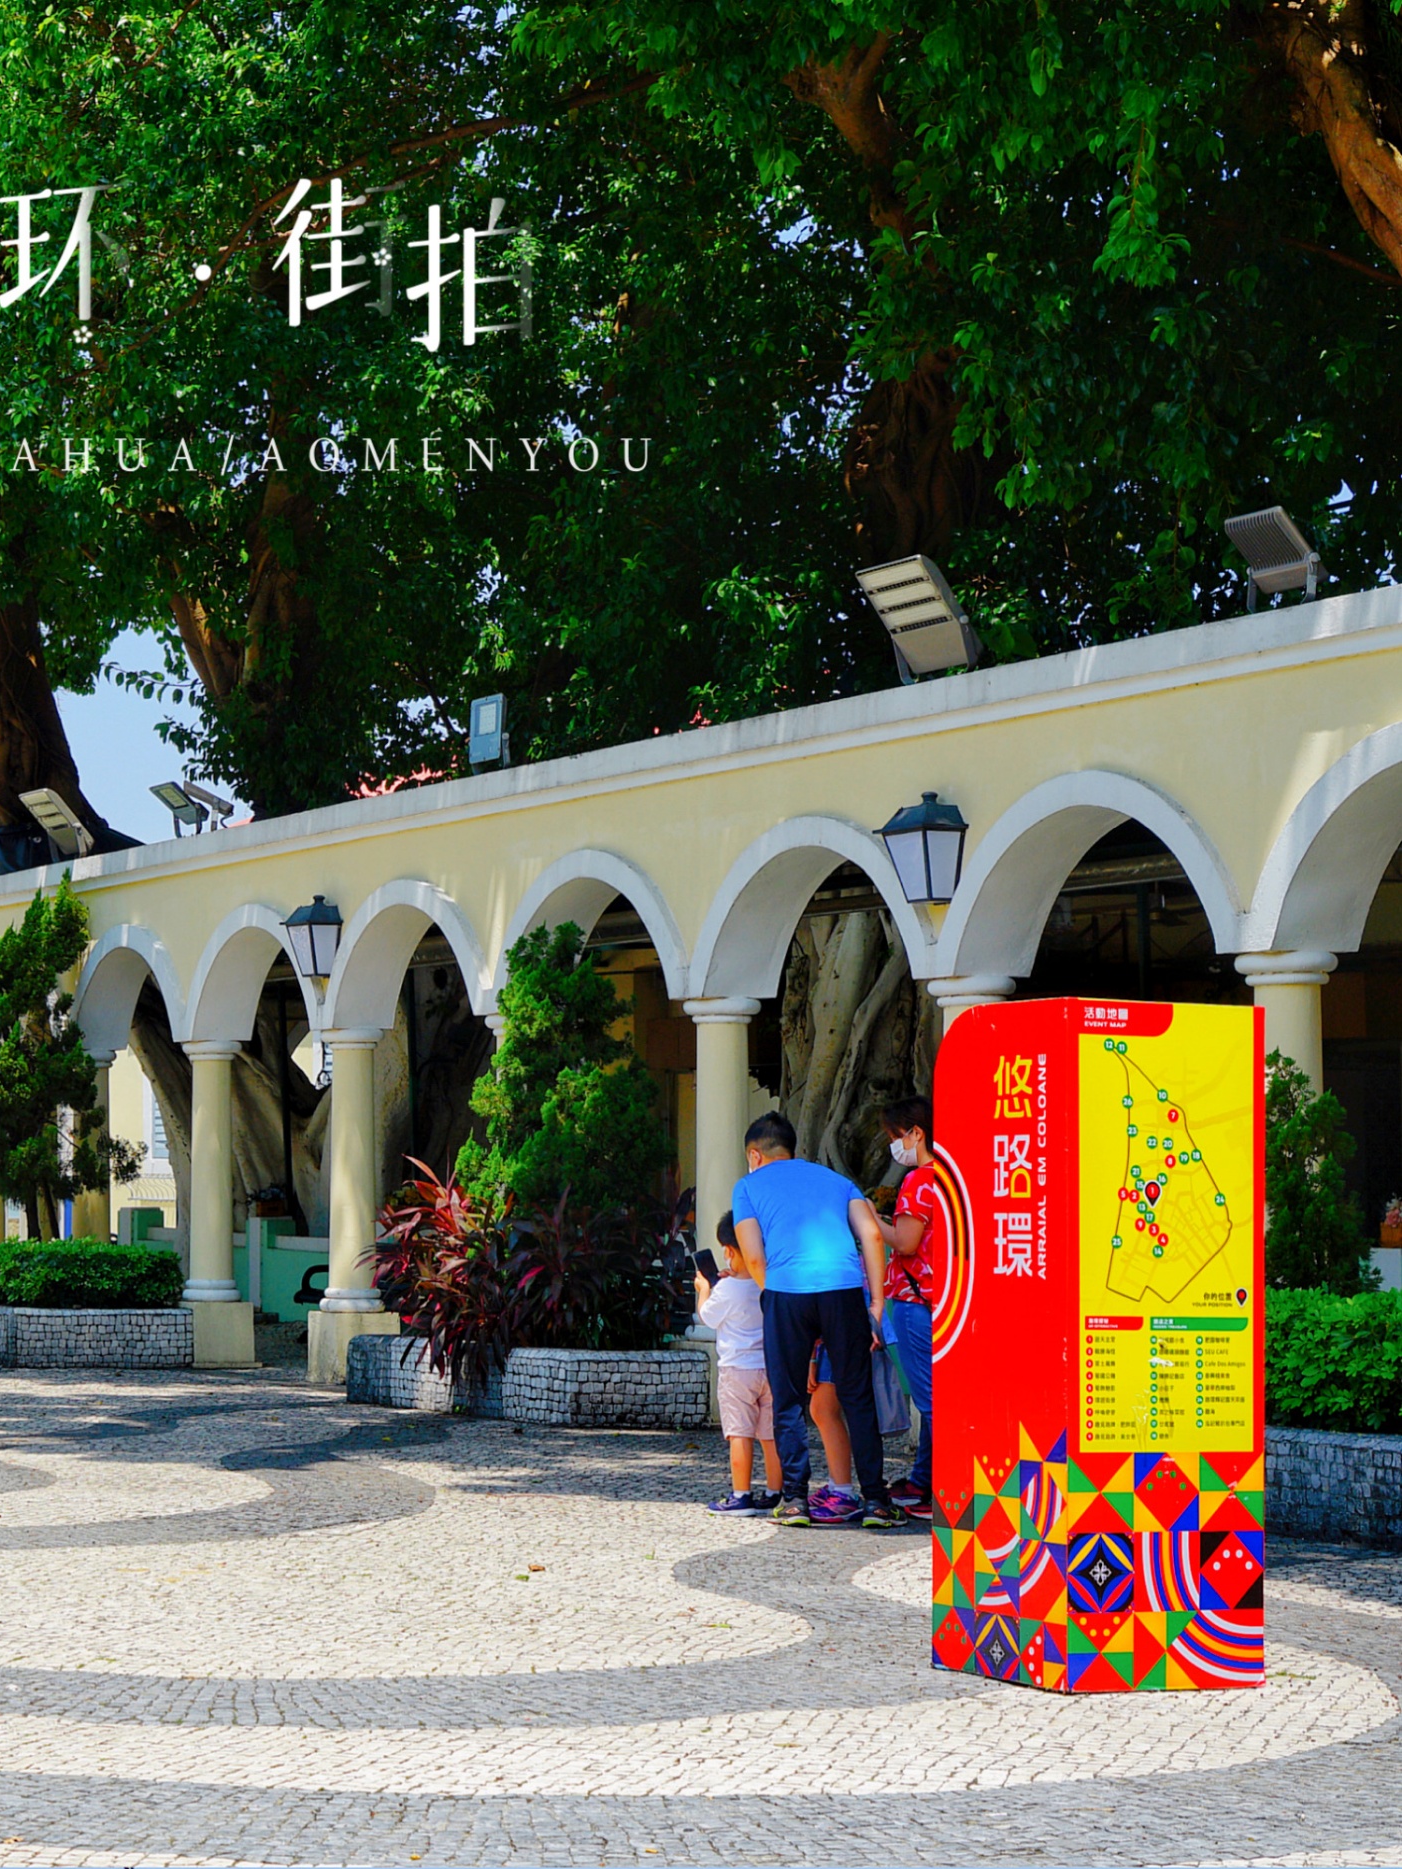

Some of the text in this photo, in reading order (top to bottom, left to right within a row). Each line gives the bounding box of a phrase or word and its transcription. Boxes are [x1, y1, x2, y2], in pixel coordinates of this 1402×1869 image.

[993, 1055, 1033, 1277] 悠路環
[1038, 1053, 1047, 1280] ARRAIAL EM COLOANE
